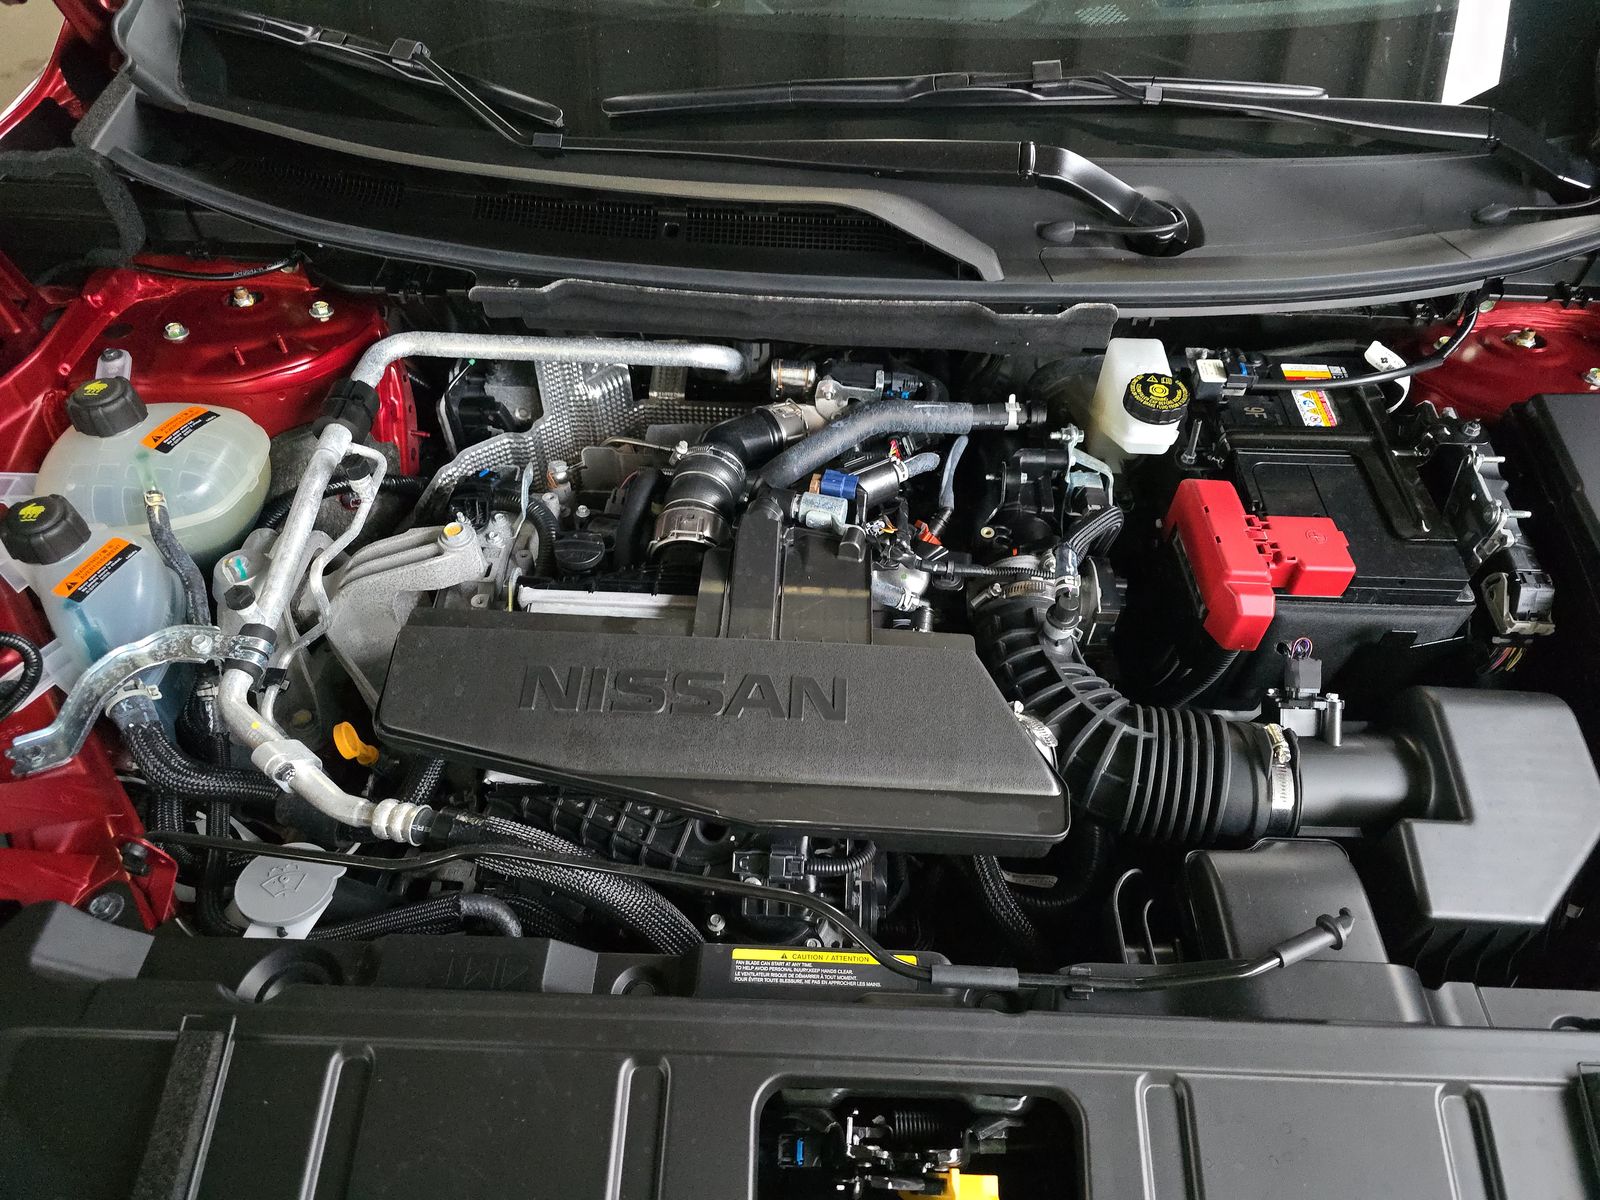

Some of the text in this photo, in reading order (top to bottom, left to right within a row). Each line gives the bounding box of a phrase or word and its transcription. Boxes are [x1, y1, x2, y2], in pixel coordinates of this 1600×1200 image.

[518, 665, 849, 723] NISSAN
[792, 953, 824, 961] CAUTION
[831, 954, 870, 963] ATTENTION
